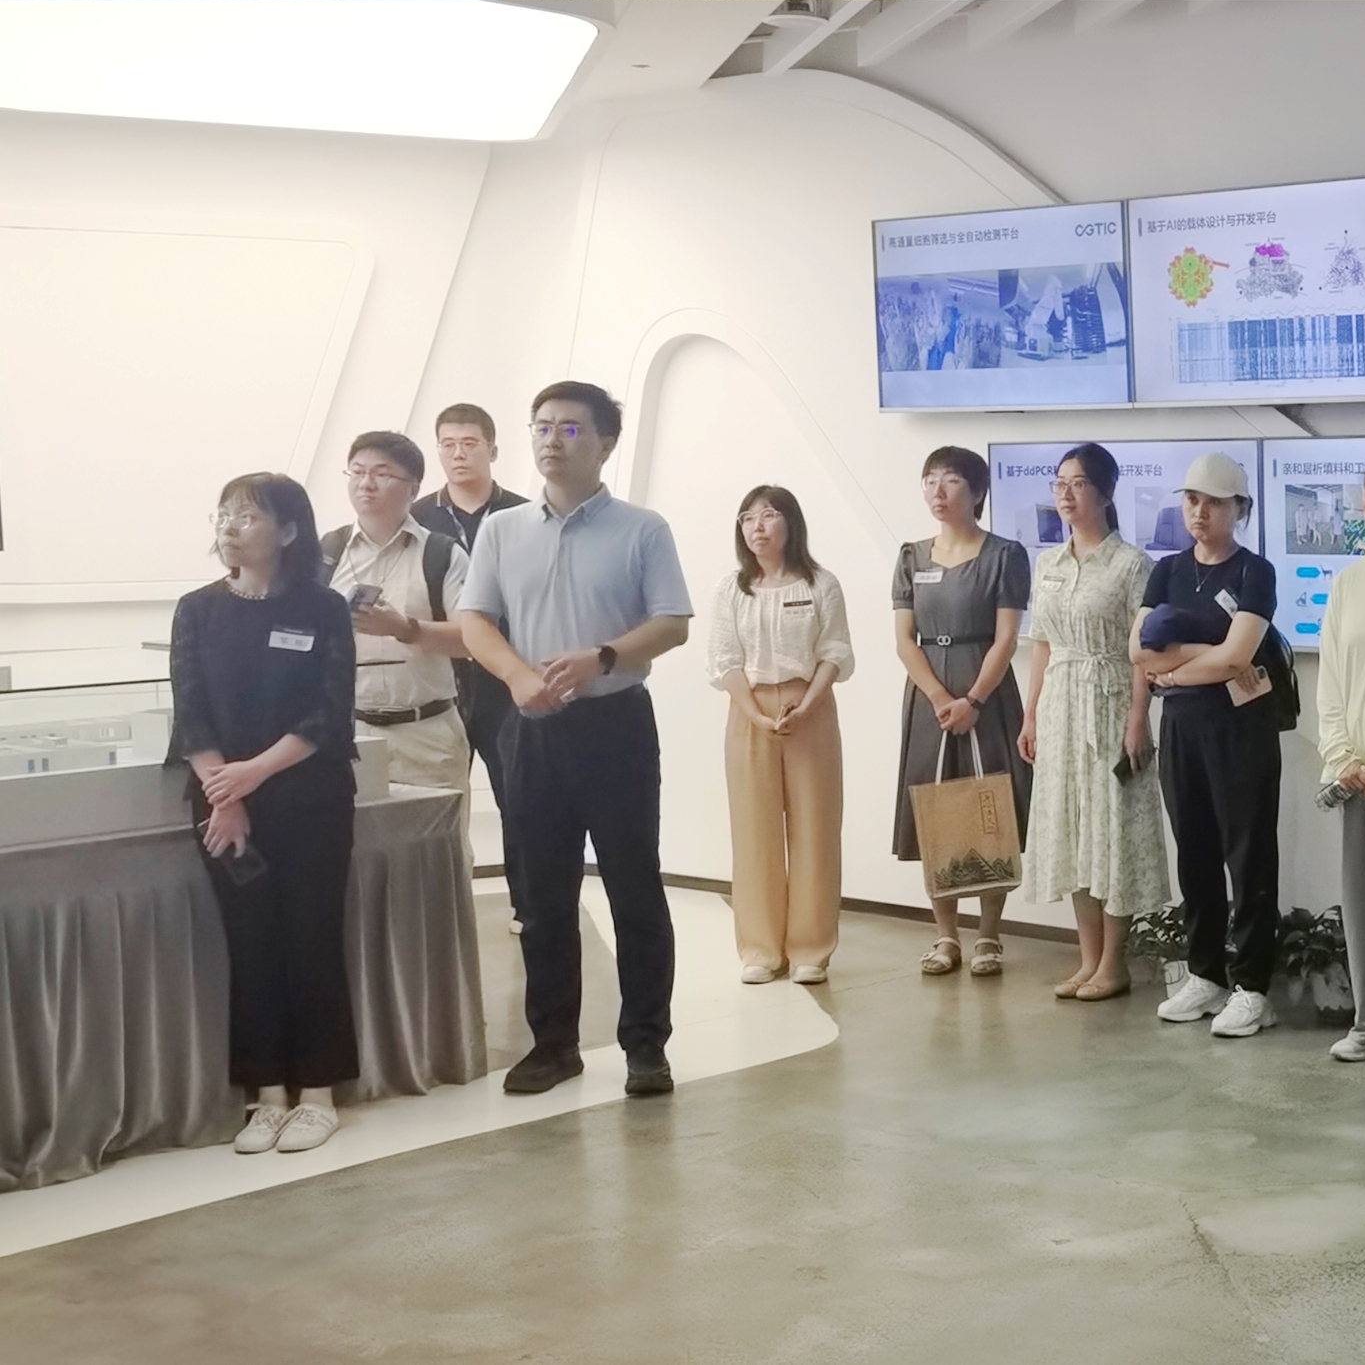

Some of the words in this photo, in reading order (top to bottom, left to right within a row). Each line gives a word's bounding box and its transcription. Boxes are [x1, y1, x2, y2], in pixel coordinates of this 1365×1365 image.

[1146, 210, 1277, 235] 基于AI的载体设计与开发平台
